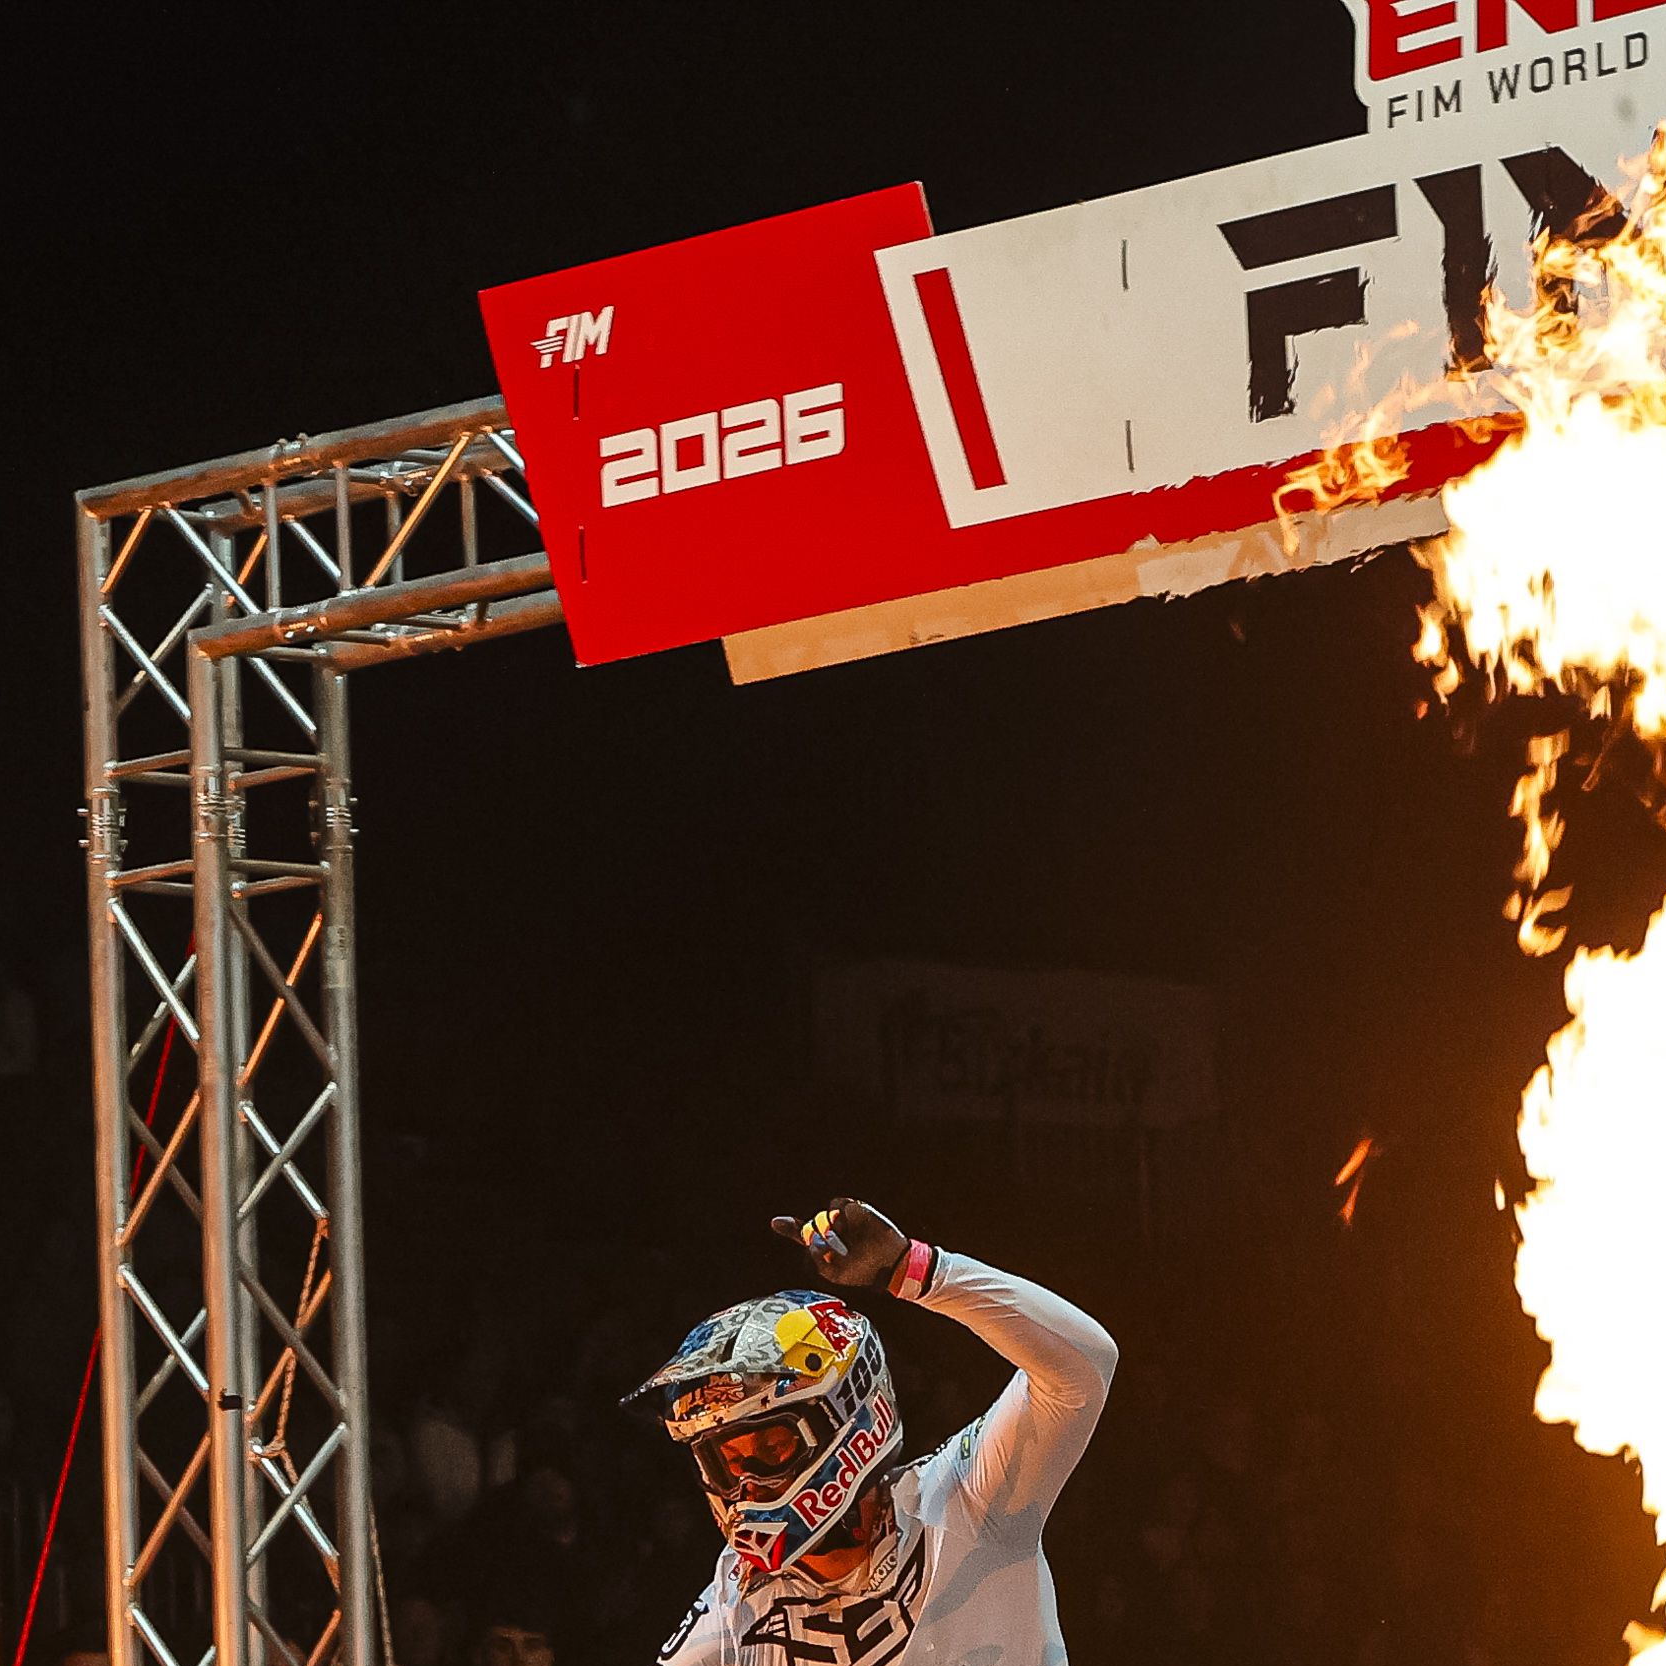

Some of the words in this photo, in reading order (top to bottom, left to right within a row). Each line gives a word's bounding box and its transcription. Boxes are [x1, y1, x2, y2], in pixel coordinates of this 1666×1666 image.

[1387, 80, 1462, 128] FIM
[1488, 32, 1649, 104] WORLD
[531, 306, 614, 368] FIM
[599, 382, 845, 509] 2026
